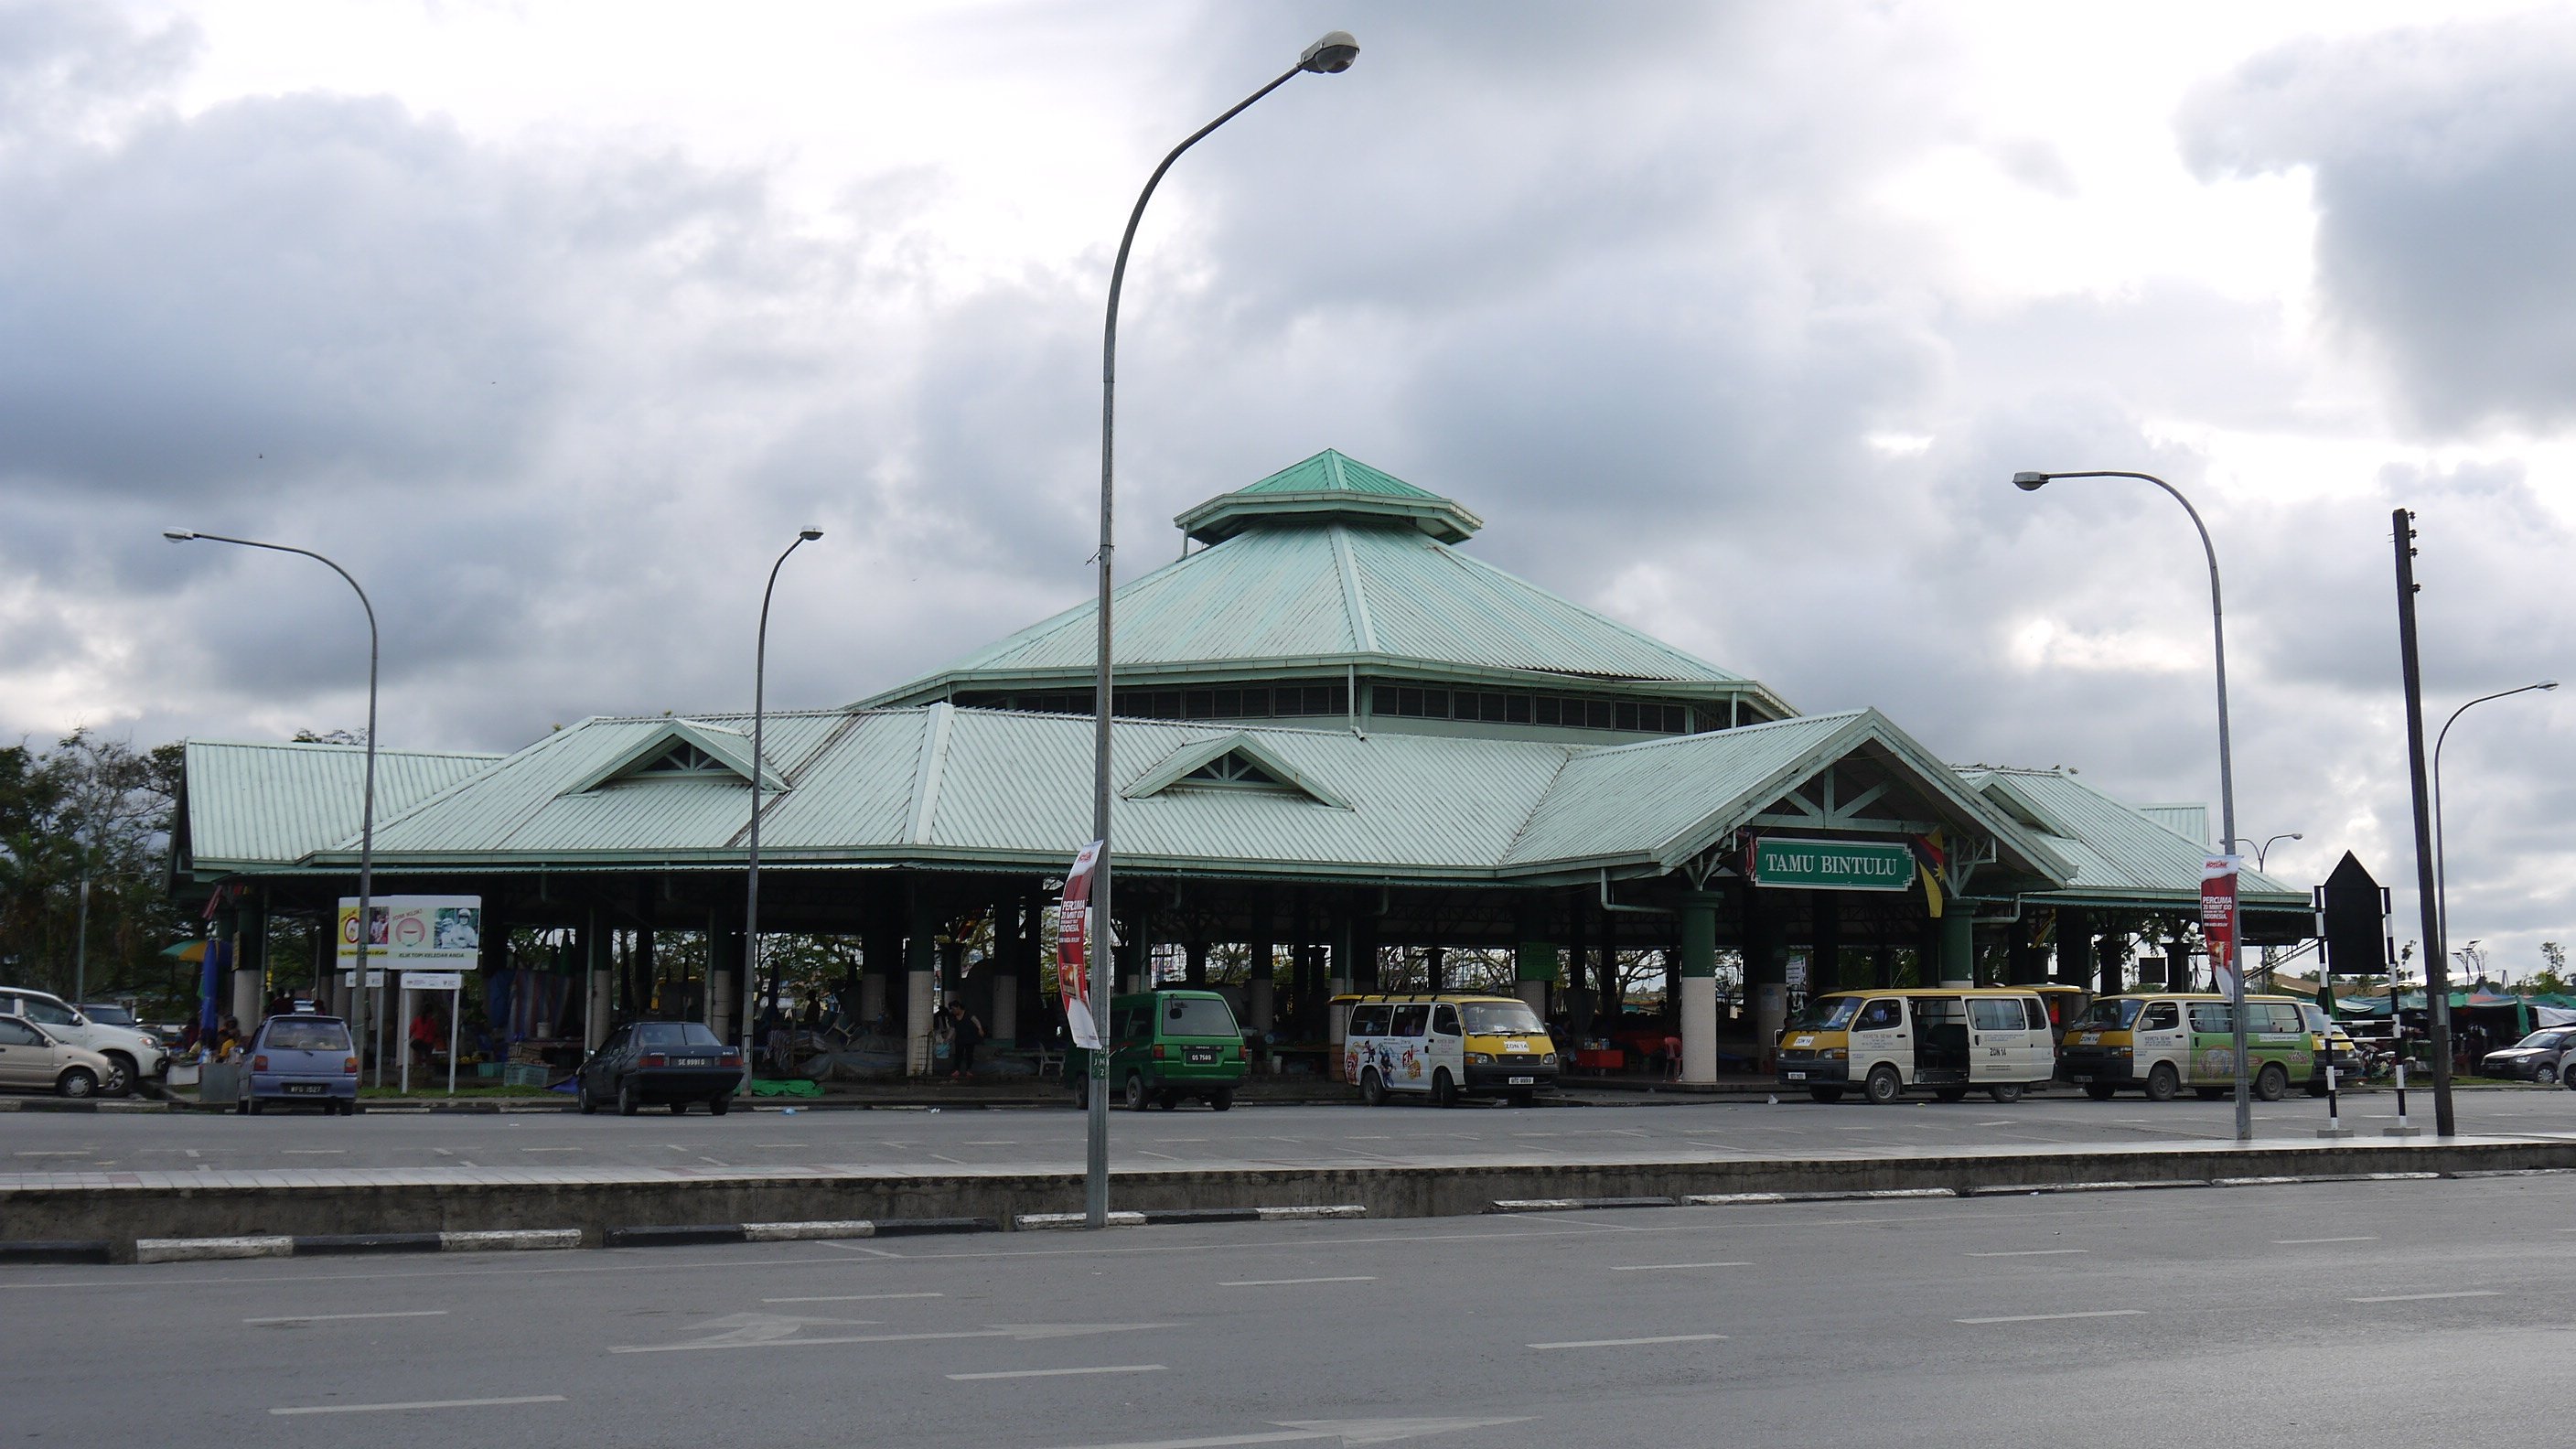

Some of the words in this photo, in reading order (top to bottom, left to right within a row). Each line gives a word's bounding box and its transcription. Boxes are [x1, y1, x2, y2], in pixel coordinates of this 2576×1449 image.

[1766, 853, 1815, 873] TAMU
[1820, 855, 1897, 875] BINTULU
[1062, 900, 1085, 911] PERCUMA
[1990, 1047, 2000, 1056] ZON
